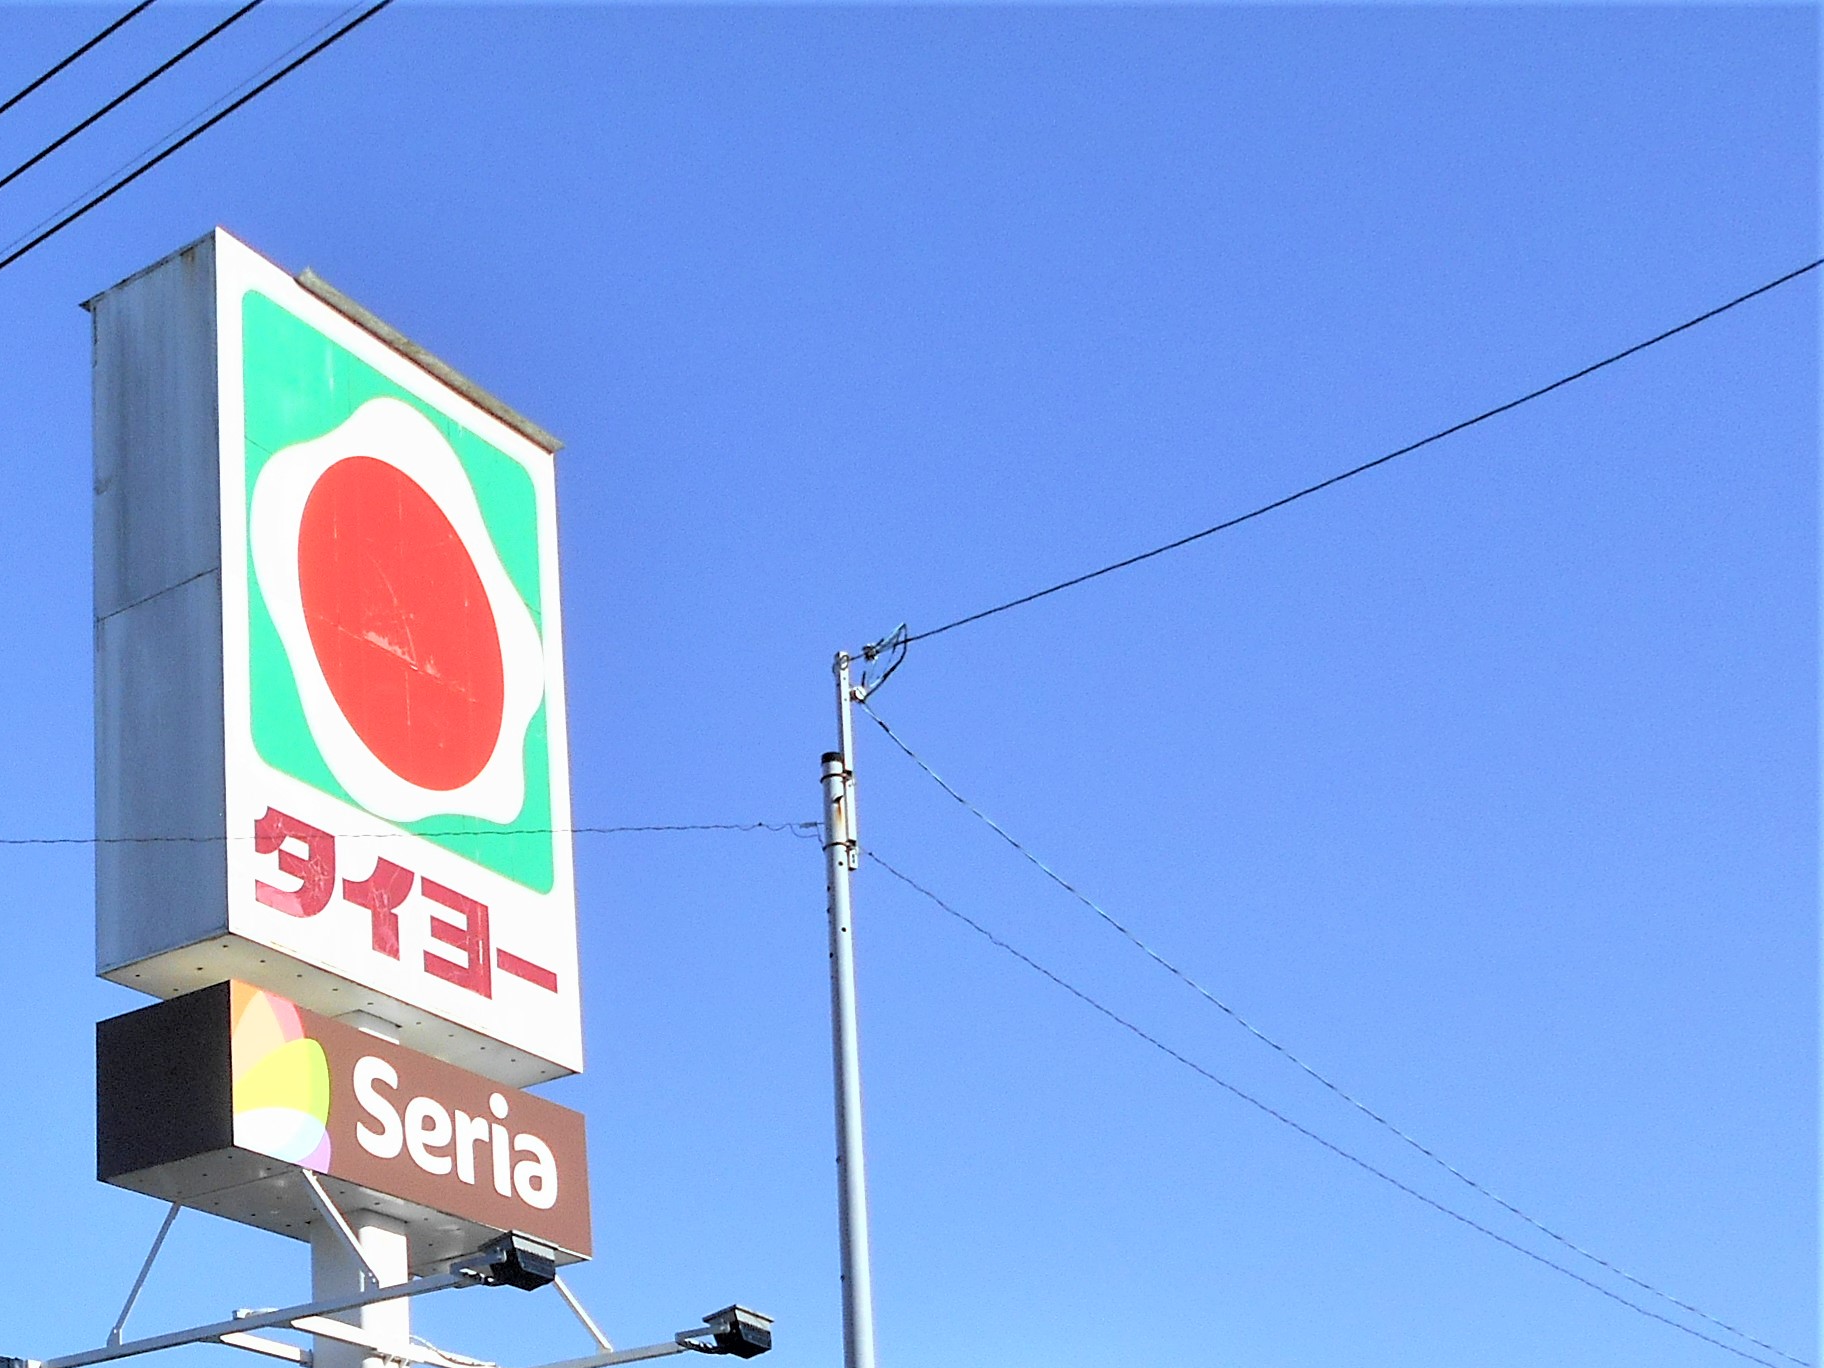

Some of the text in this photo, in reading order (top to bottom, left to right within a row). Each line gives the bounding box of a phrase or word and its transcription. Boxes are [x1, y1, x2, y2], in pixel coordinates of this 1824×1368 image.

[254, 805, 558, 1000] タイヨー
[352, 1055, 558, 1209] Seria
